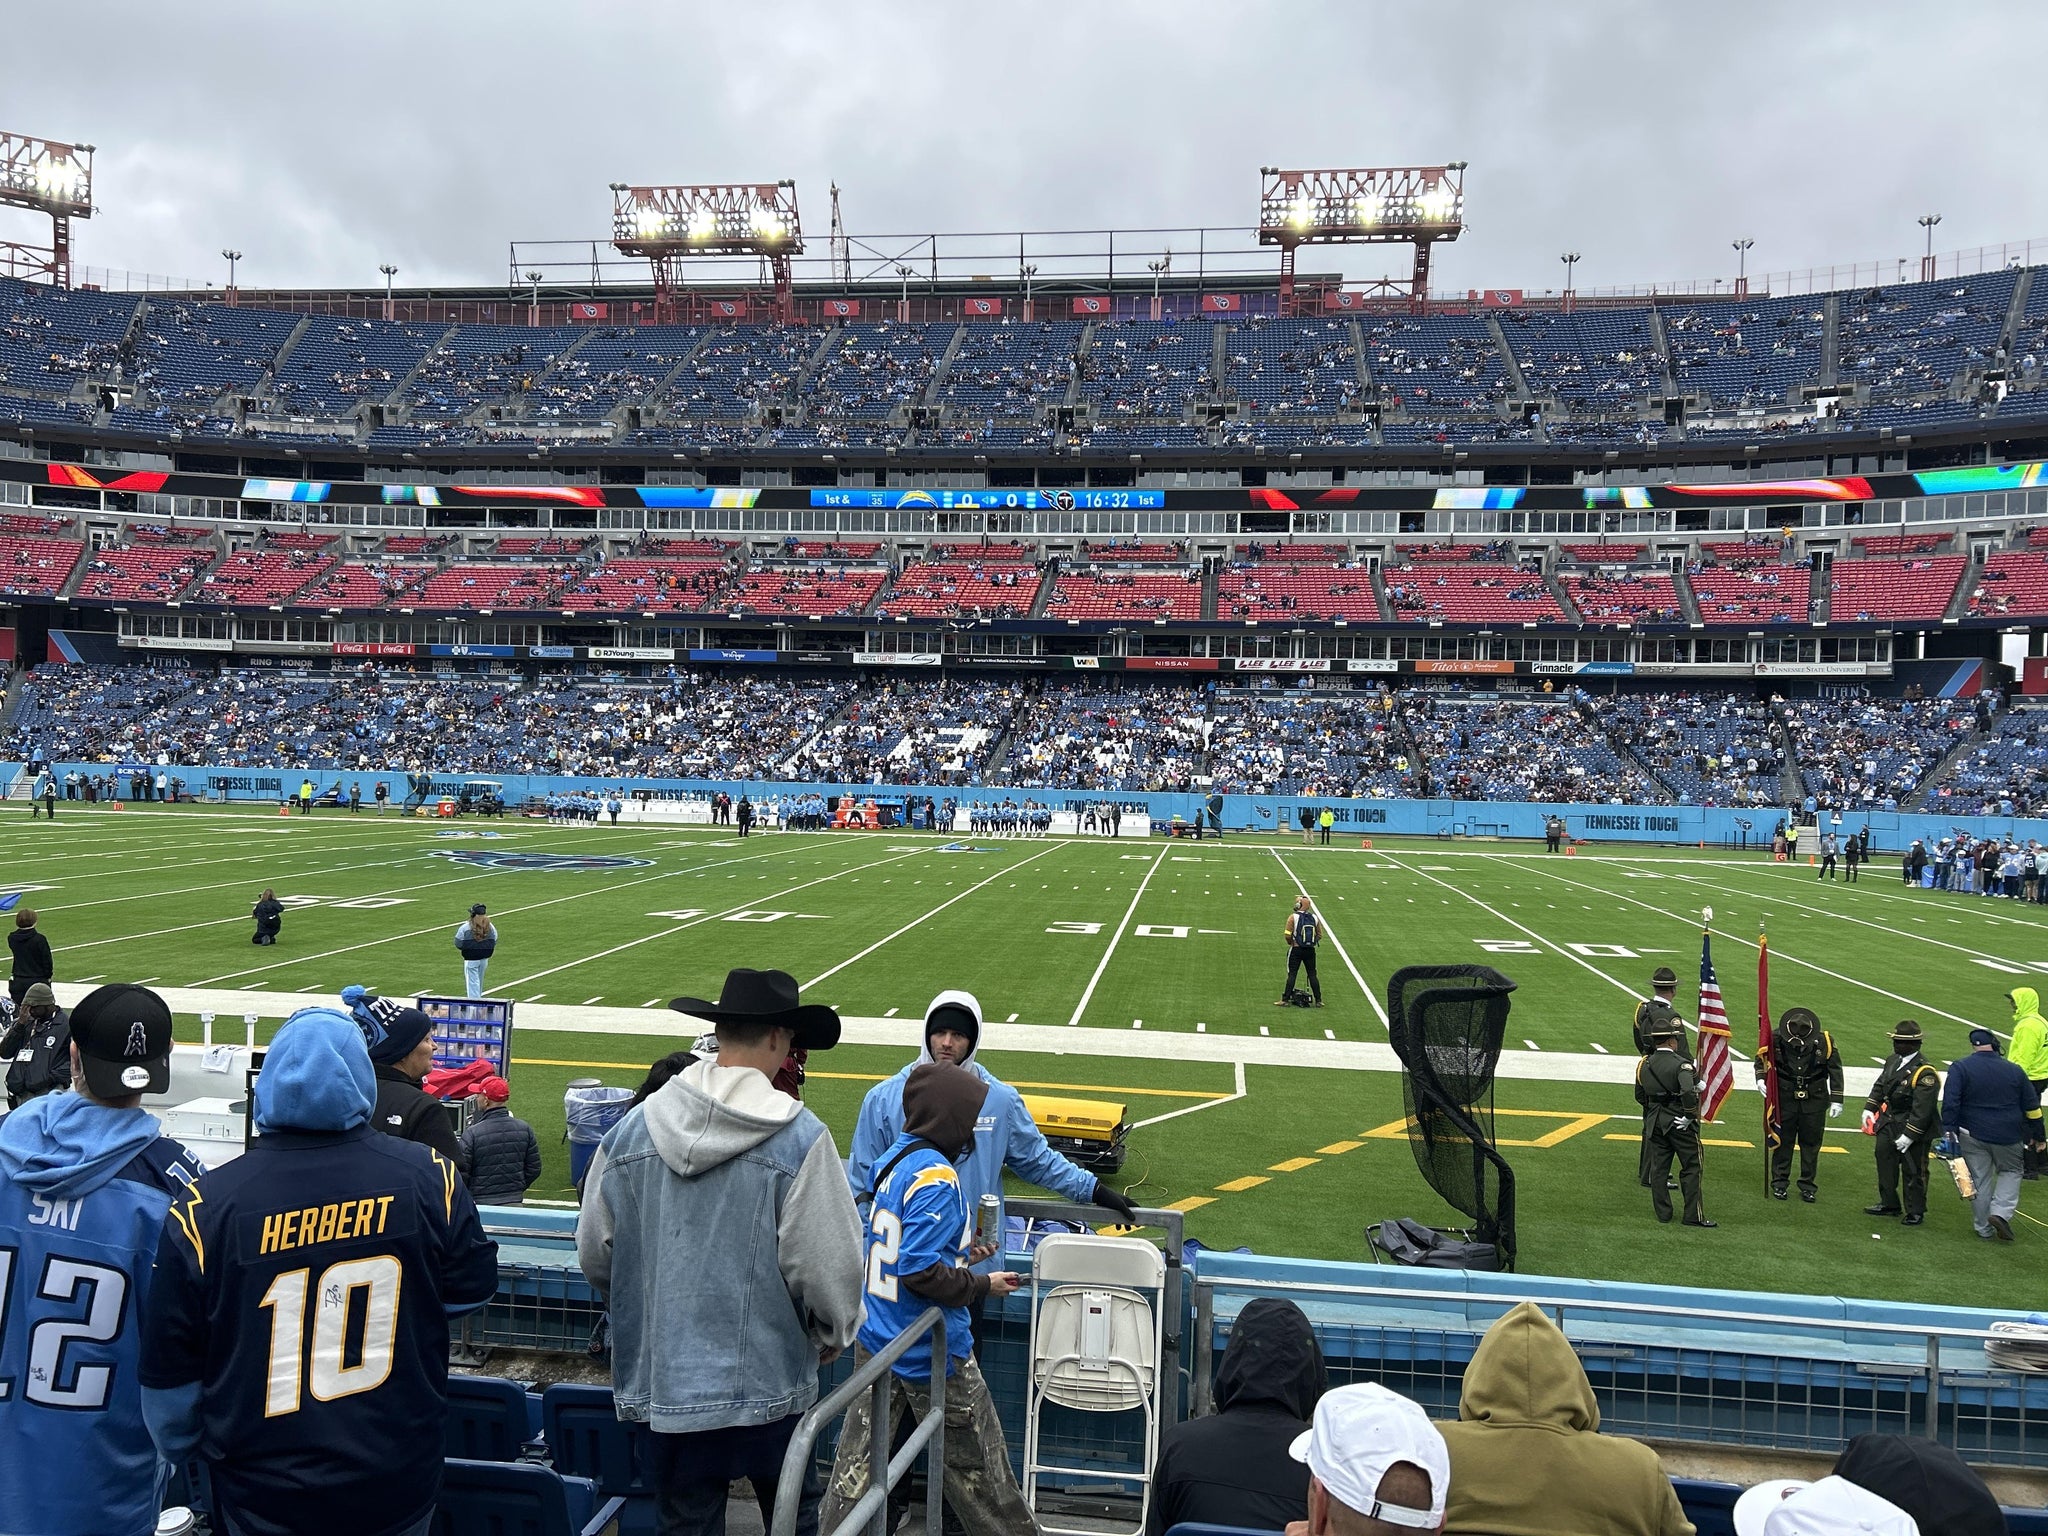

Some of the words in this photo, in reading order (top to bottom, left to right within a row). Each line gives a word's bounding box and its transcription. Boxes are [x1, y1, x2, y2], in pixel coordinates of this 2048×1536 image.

[825, 494, 840, 504] 1st
[841, 494, 851, 504] &
[961, 493, 973, 507] 0
[1006, 493, 1018, 507] 0
[1085, 493, 1130, 508] 16:32
[1138, 495, 1155, 505] 1st
[603, 649, 635, 658] RJYoung
[250, 658, 273, 666] RING
[280, 659, 313, 667] HONOR
[1431, 662, 1459, 672] Tito's
[1533, 663, 1574, 673] Pinnacle
[1316, 675, 1352, 683] ROBERT
[1425, 677, 1448, 685] EARL
[1316, 682, 1354, 691] BRAZILE
[1817, 682, 1870, 697] TITANS
[255, 777, 282, 791] TOUGH
[1353, 808, 1387, 823] TOUGH
[1584, 815, 1641, 831] TENNESSEE
[1644, 816, 1679, 832] TOUGH
[1363, 840, 1372, 848] 20
[260, 1195, 395, 1255] HERBERT
[258, 1255, 403, 1419] 10
